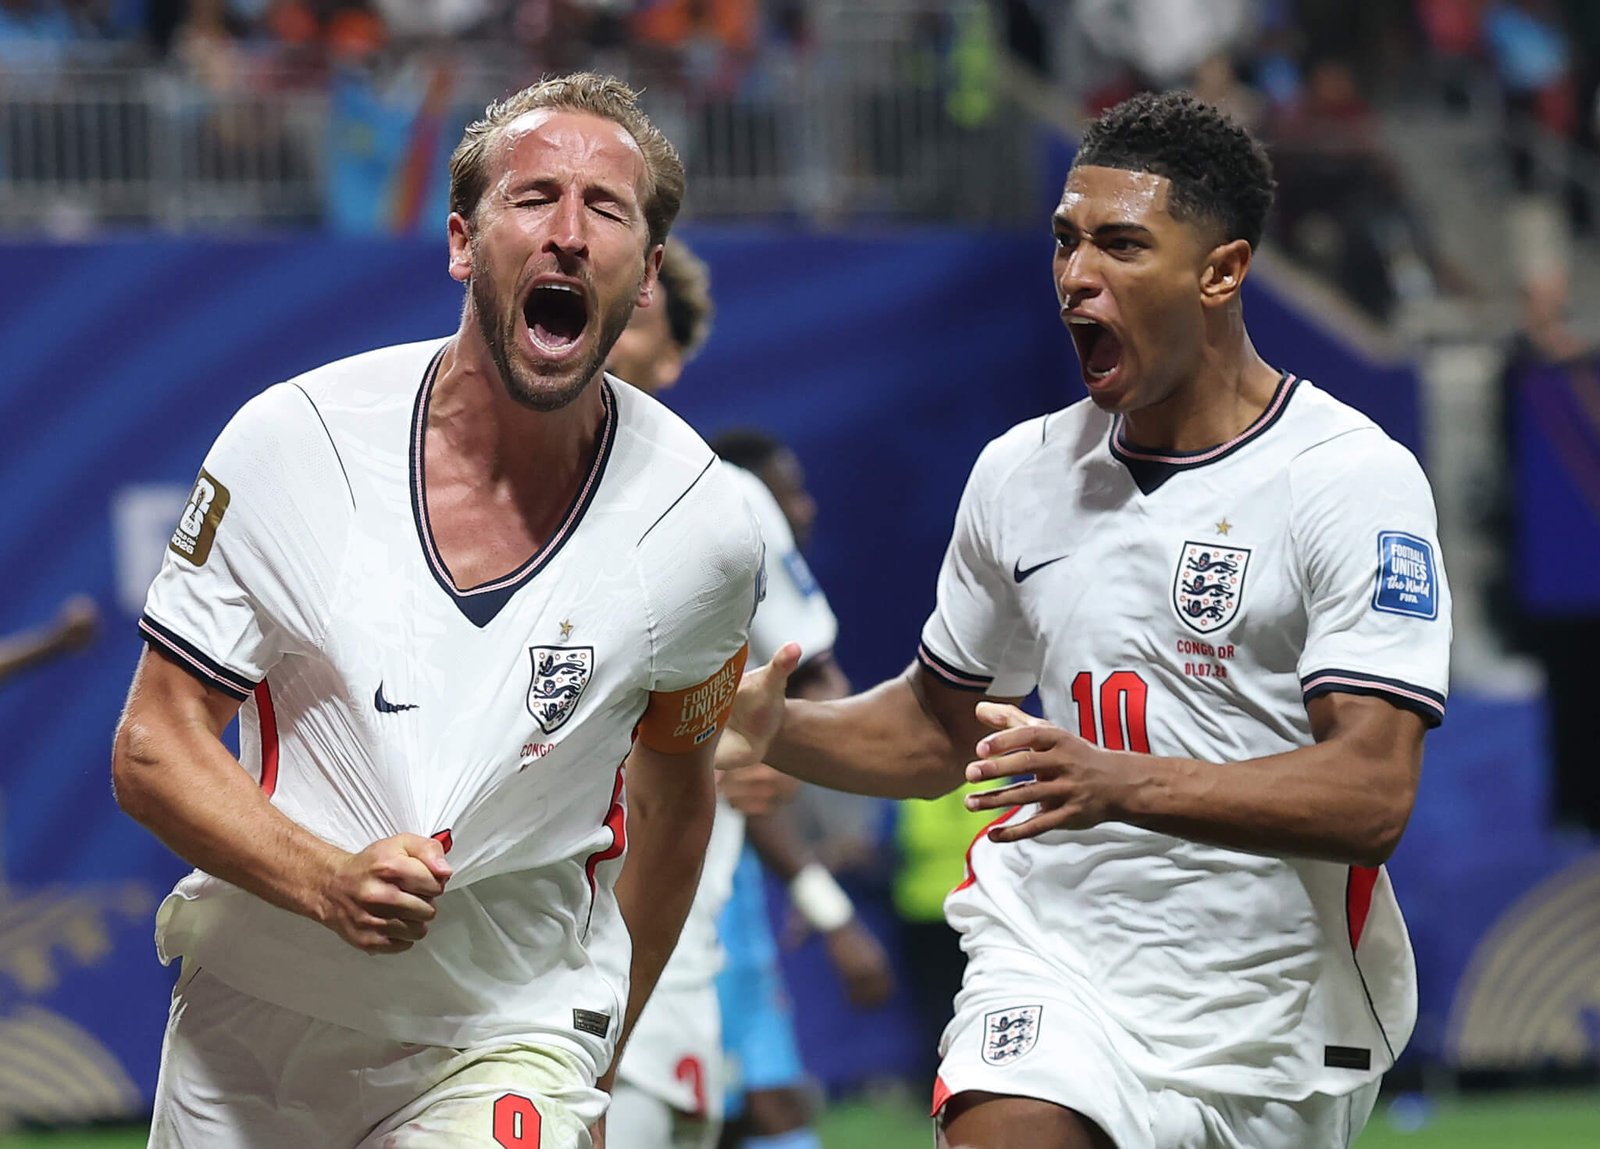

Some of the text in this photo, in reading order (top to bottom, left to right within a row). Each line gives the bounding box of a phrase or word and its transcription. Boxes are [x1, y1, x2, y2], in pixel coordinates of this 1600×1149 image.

[1391, 543, 1426, 564] FOOTBALL
[1391, 556, 1427, 581] UNITES
[1386, 575, 1430, 598] the World
[1399, 592, 1418, 603] FIFA
[1177, 640, 1235, 659] CONGO DR
[1185, 662, 1227, 679] 01.07.26
[683, 662, 737, 707] FOOTBALL
[681, 675, 735, 722] UNITES
[1071, 671, 1151, 754] 10
[695, 723, 717, 744] FIFA
[493, 1082, 542, 1149] 9
